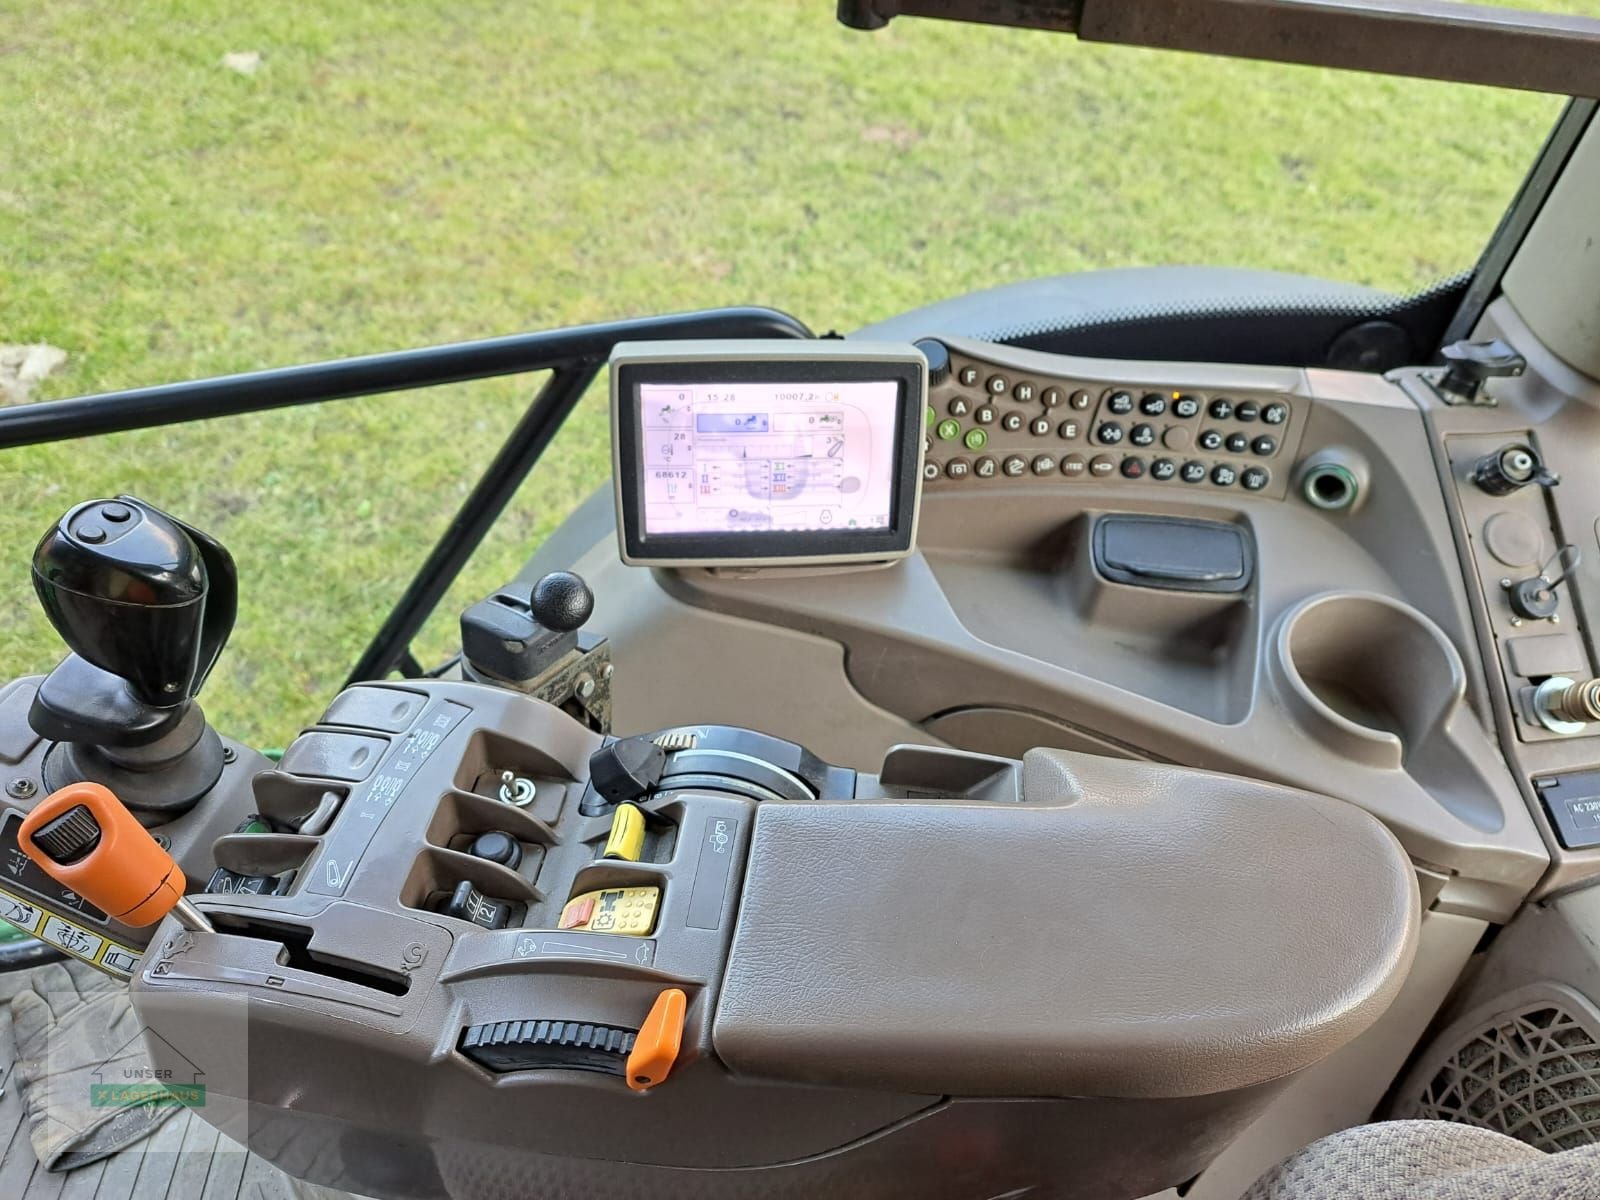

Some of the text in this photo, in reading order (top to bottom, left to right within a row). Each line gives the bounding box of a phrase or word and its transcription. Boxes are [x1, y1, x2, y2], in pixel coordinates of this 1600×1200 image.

[967, 371, 976, 383] F
[993, 380, 1004, 392] G
[1020, 387, 1032, 399] H
[1051, 392, 1056, 404] I
[1078, 395, 1089, 407] J
[955, 402, 966, 413] A
[982, 410, 992, 422] B
[1009, 417, 1020, 429] C
[1038, 421, 1048, 433] D
[1066, 425, 1076, 437] E
[480, 907, 494, 918] 2
